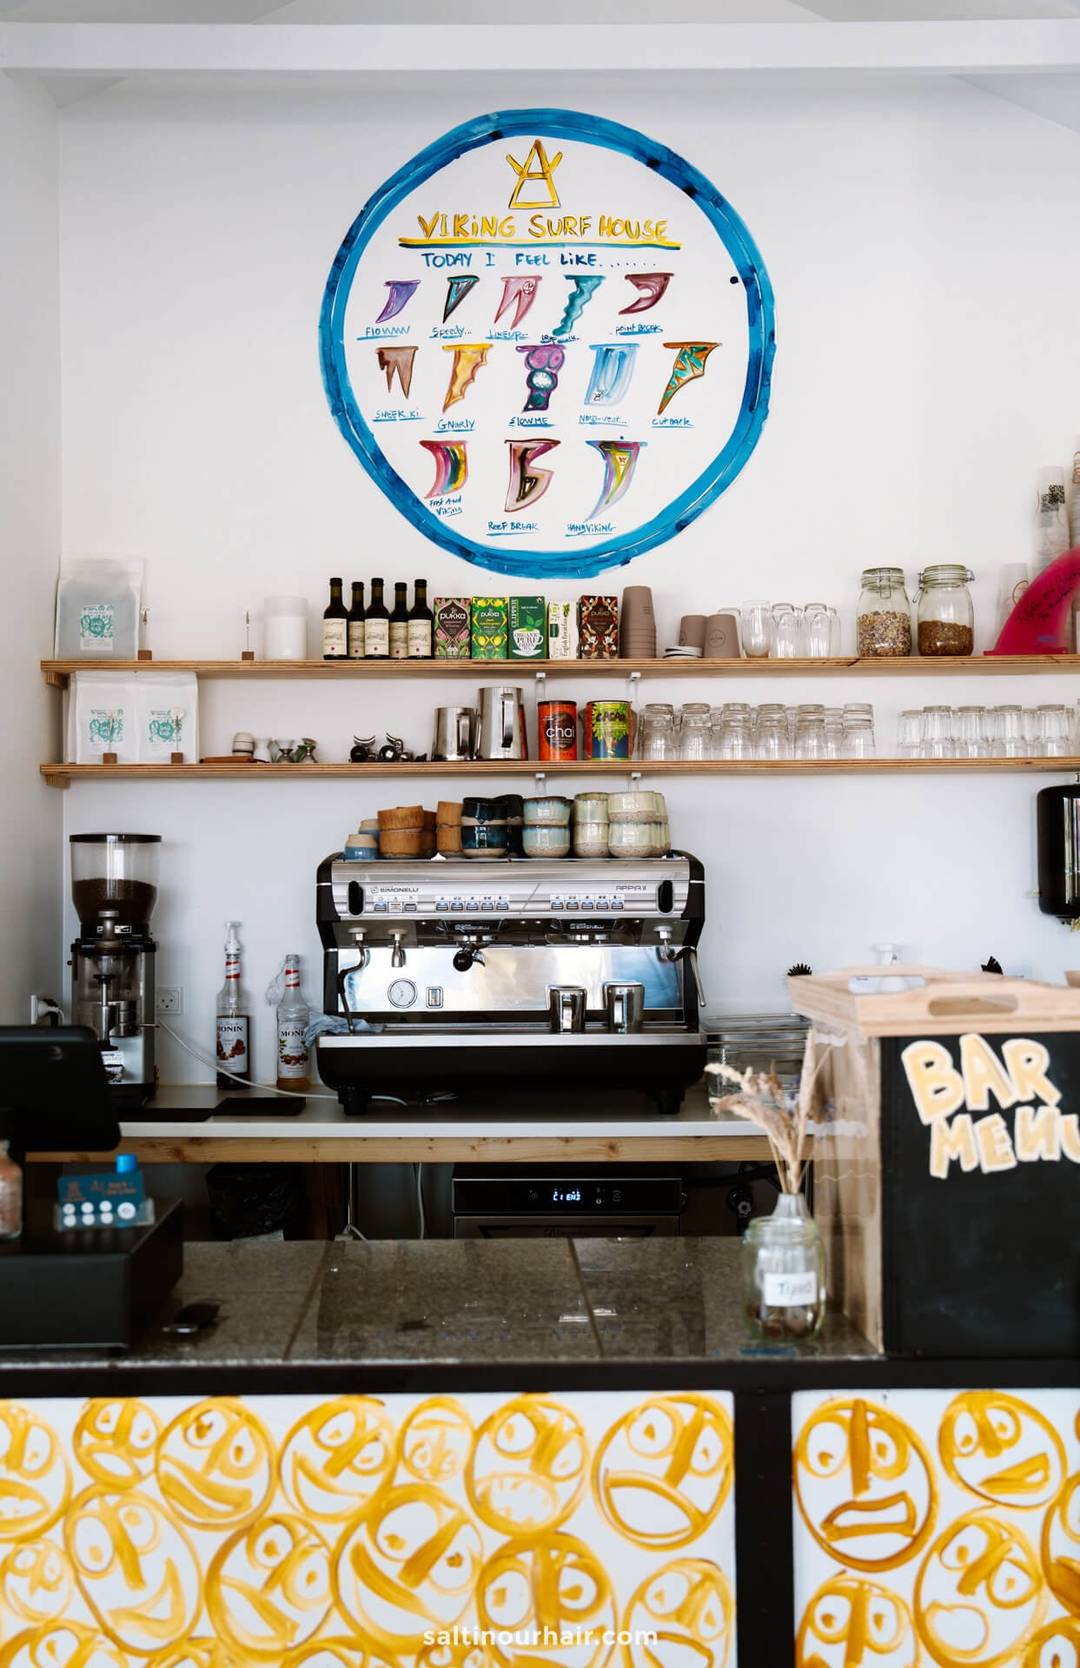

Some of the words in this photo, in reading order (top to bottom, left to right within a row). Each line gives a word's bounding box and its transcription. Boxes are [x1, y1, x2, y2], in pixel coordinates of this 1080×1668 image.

[528, 214, 592, 239] SURF
[599, 215, 669, 241] HOUSE
[421, 252, 472, 269] TODAY
[485, 252, 495, 267] I
[515, 253, 550, 267] FEEL
[546, 726, 575, 738] chai
[901, 1033, 1062, 1126] BAR
[929, 1105, 1080, 1180] MENU
